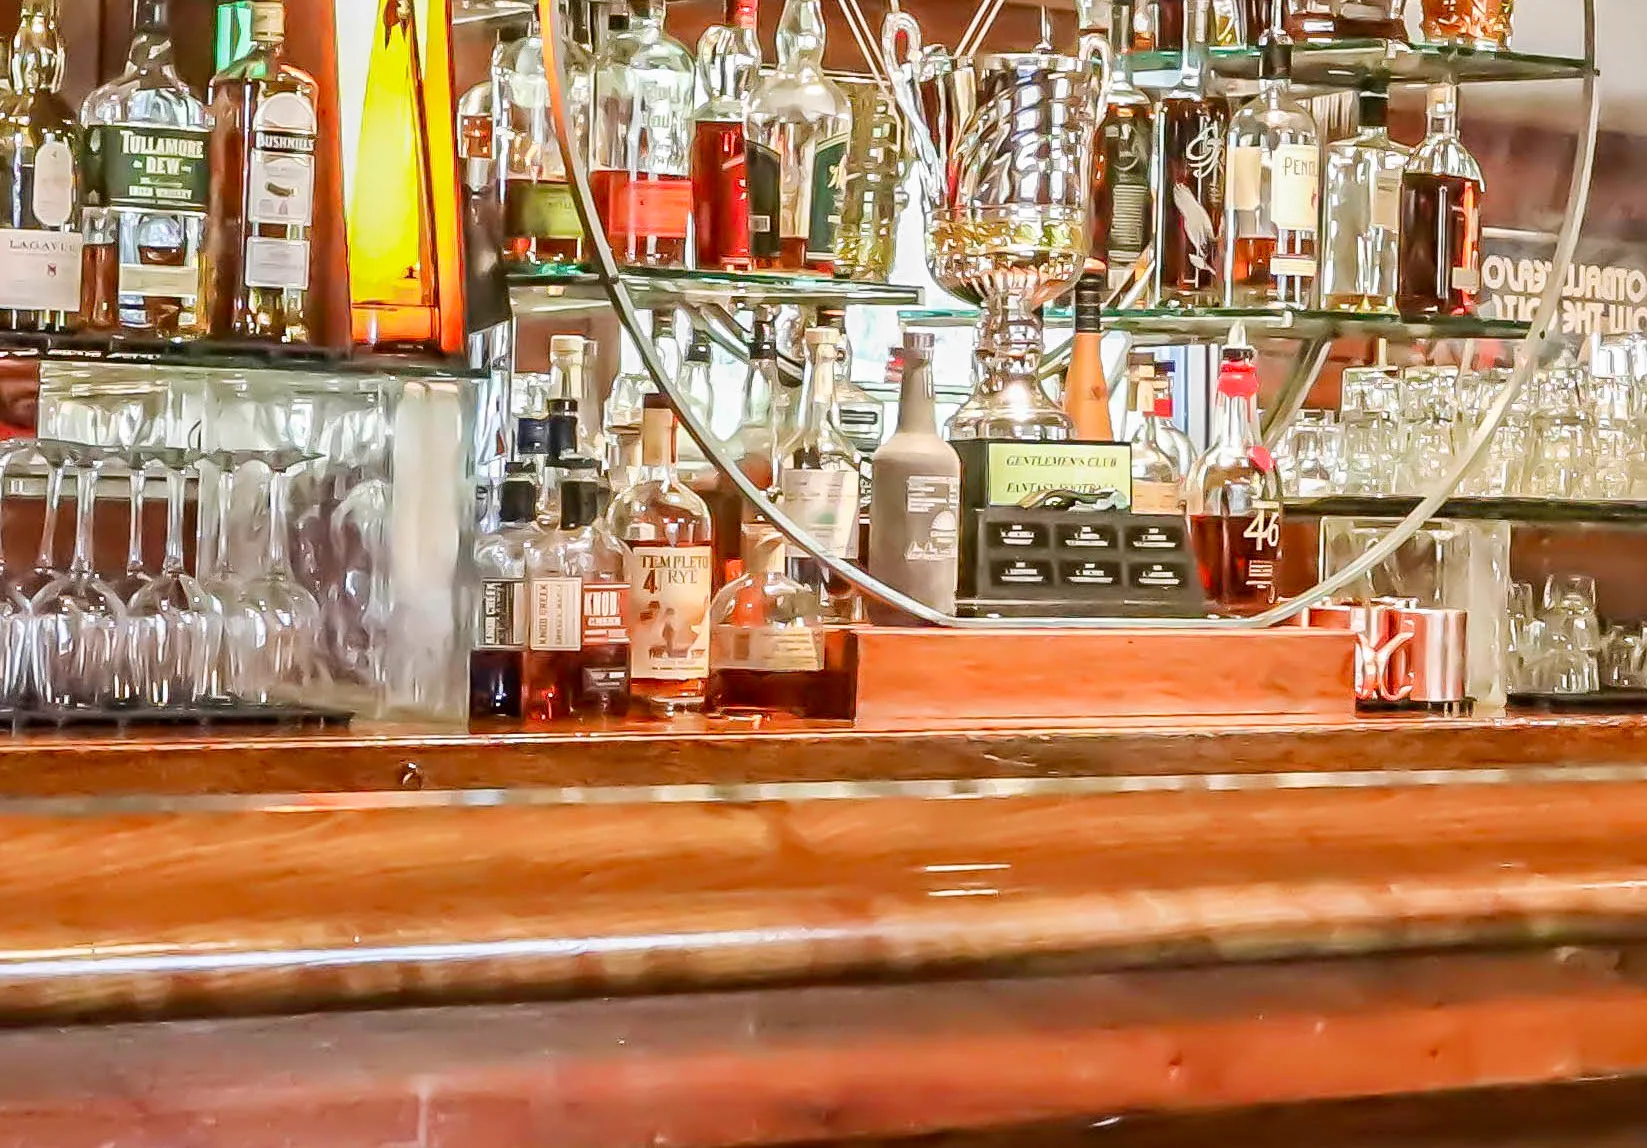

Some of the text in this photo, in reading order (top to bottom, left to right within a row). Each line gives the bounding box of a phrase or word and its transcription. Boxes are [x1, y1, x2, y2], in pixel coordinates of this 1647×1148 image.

[1006, 456, 1117, 468] GENTLEMEN'S CLUB
[1242, 508, 1281, 551] 46
